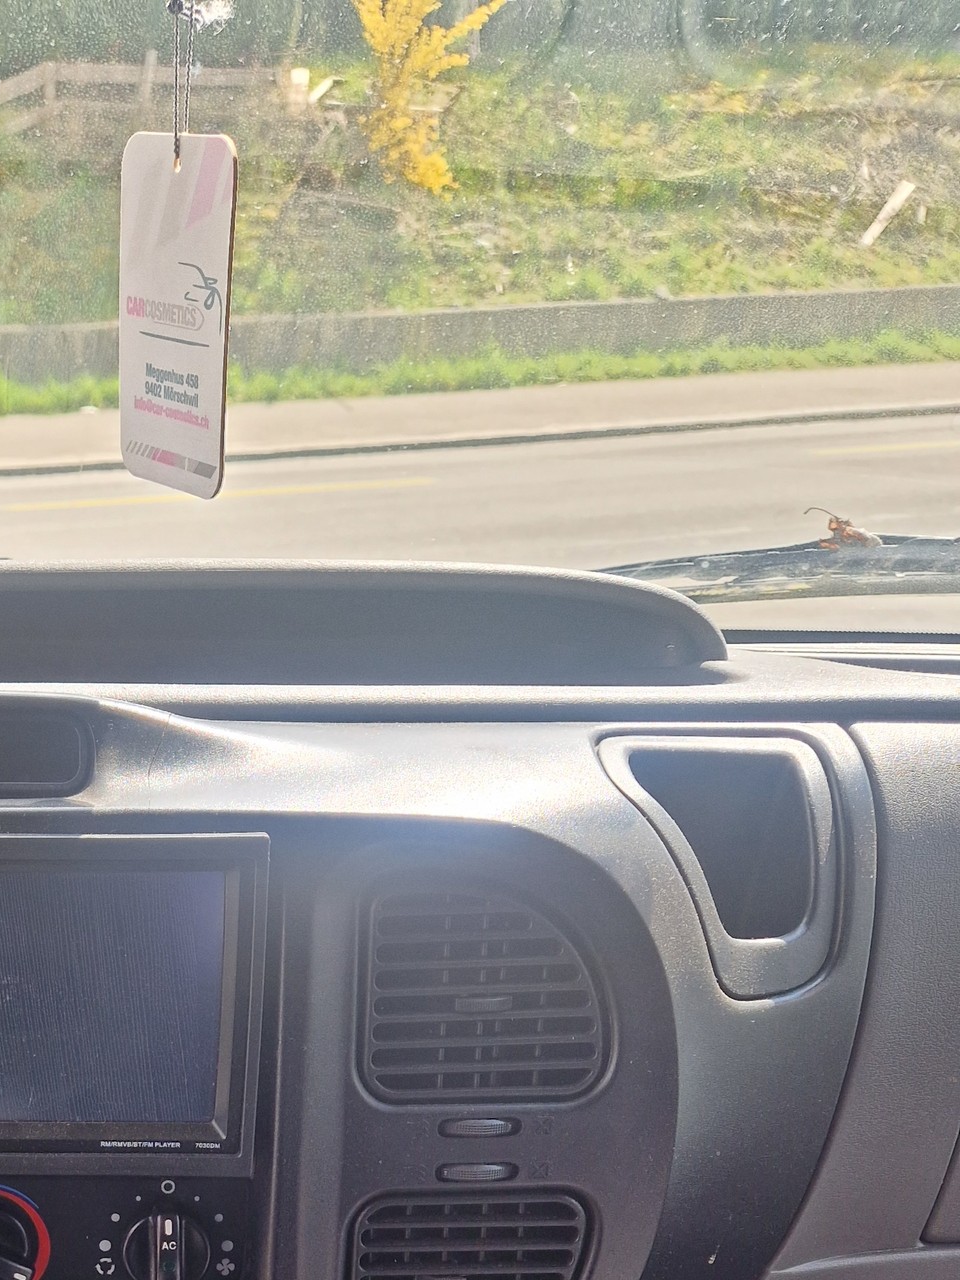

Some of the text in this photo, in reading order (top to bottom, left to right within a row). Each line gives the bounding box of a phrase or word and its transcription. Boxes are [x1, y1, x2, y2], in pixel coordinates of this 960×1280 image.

[127, 296, 197, 327] CARCOSMETICS
[145, 362, 199, 389] Meggenhus 458
[144, 381, 199, 408] 9402 Mörschwil
[161, 1241, 177, 1250] AC
